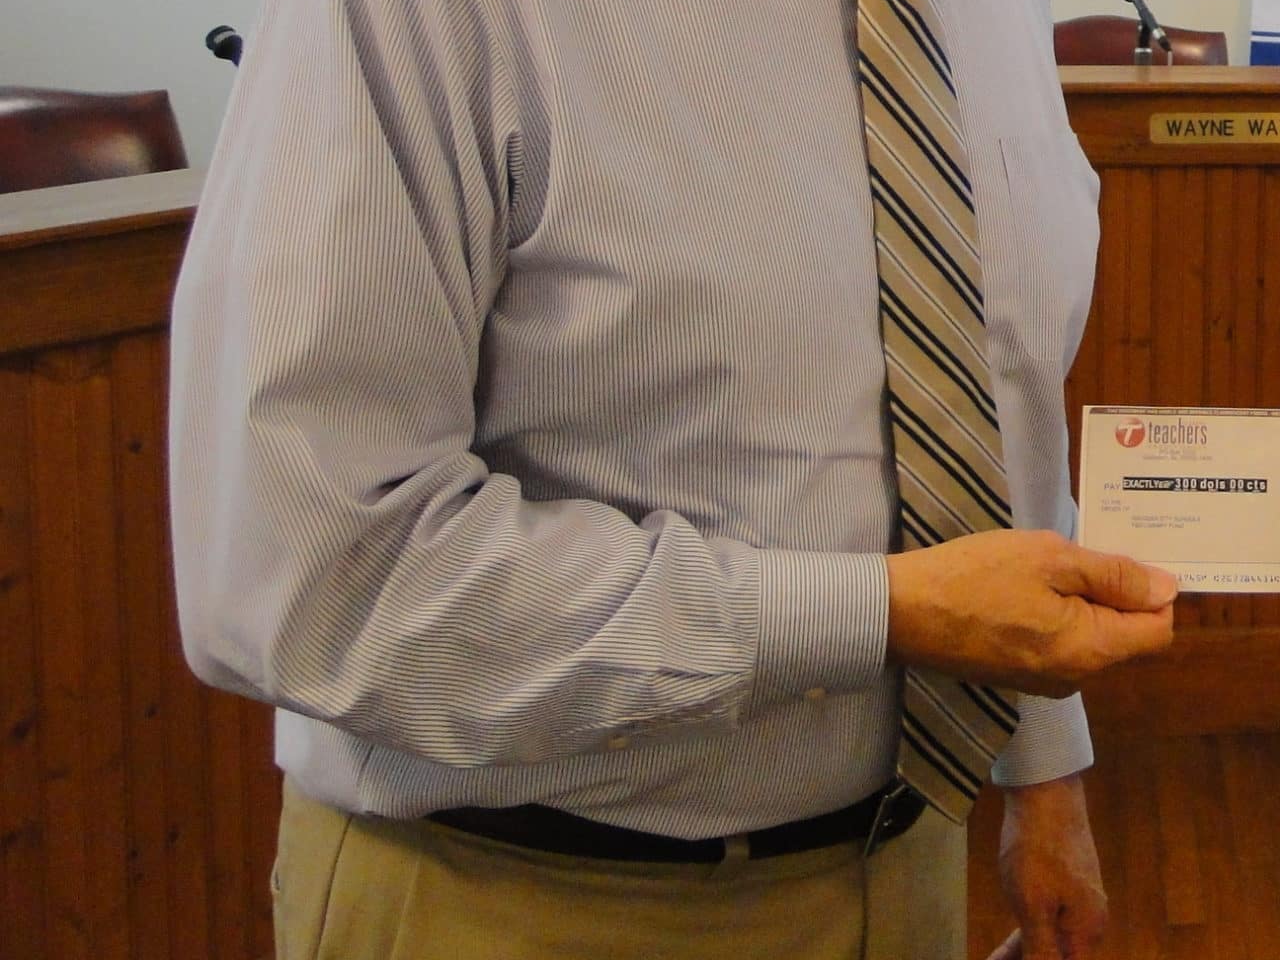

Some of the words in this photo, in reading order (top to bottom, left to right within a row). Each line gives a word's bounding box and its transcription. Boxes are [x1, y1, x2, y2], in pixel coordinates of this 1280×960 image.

[1166, 119, 1235, 137] WAYNE
[1148, 417, 1208, 445] teachers
[1104, 483, 1121, 491] PAY
[1123, 480, 1160, 489] EXACTLY
[1174, 478, 1197, 490] 300
[1200, 478, 1226, 490] dols
[1229, 479, 1244, 490] 00
[1246, 480, 1266, 490] cts
